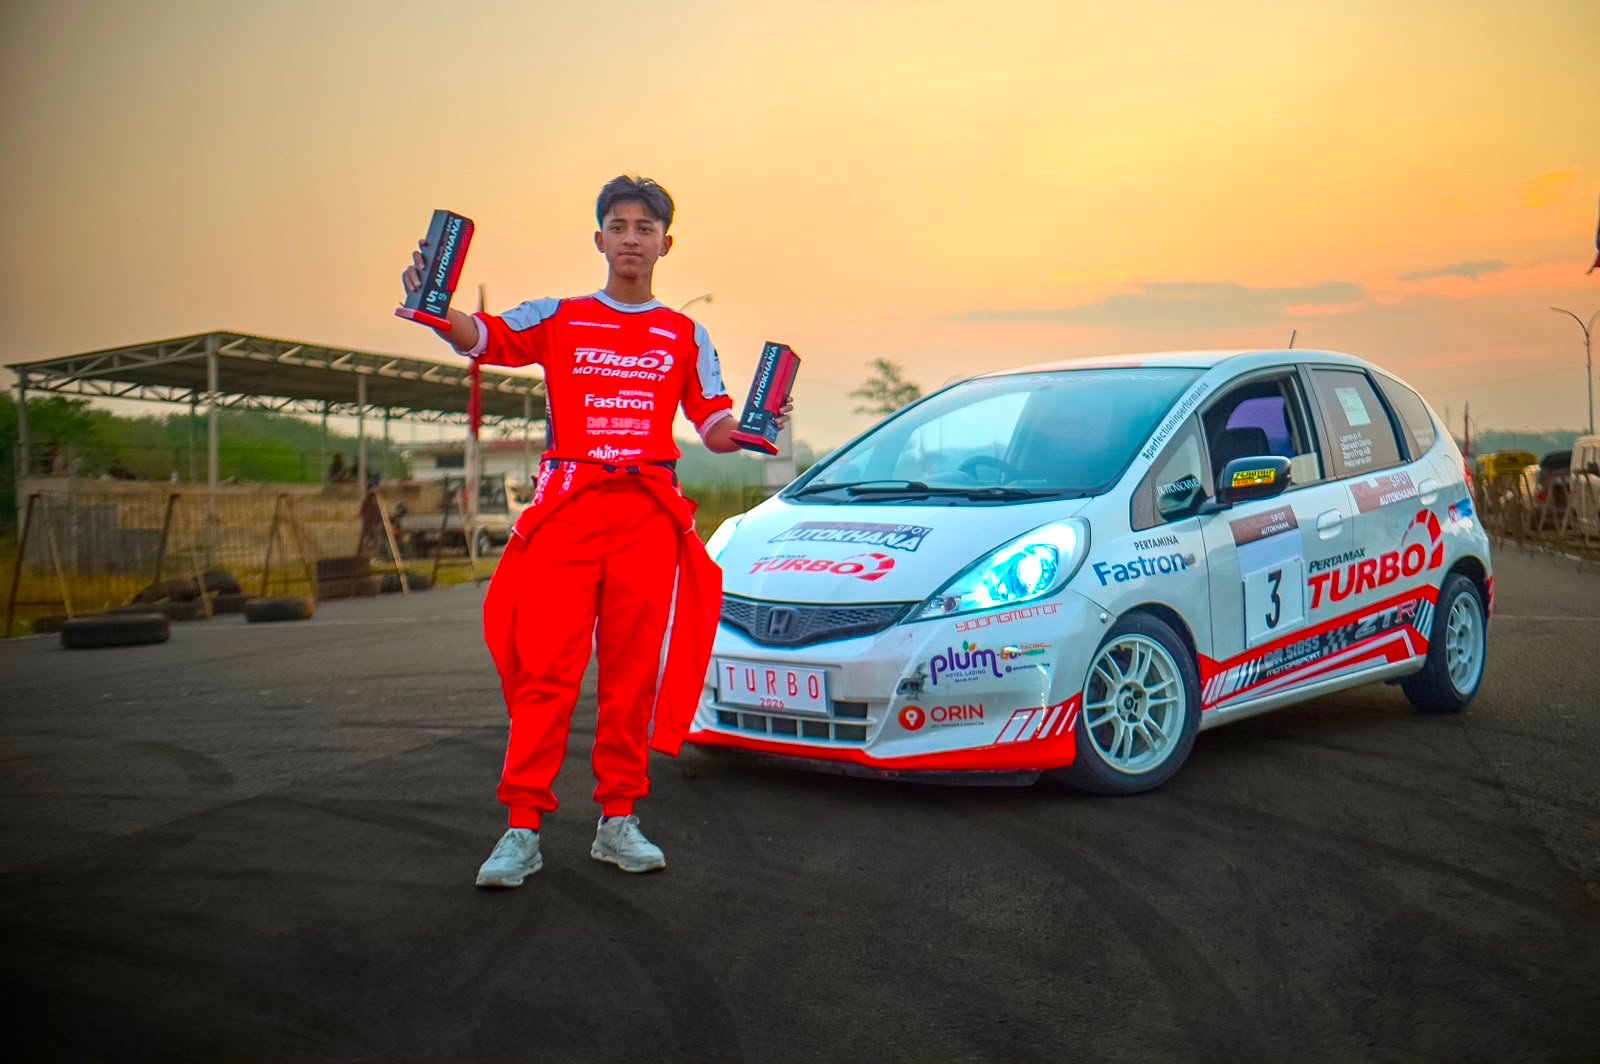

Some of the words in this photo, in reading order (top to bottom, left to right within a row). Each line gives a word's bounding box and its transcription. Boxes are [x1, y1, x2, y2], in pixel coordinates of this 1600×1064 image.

[434, 218, 462, 288] AUTOKHANA
[571, 365, 666, 382] MOTORSPORT
[573, 351, 660, 369] TURBO
[752, 344, 779, 409] AUTOKHANA
[584, 393, 655, 411] Fastron
[772, 528, 919, 550] AUTOKHANA
[894, 524, 930, 536] SPOT
[1133, 534, 1180, 552] PERTAMINA
[749, 558, 865, 575] TURBO
[1092, 552, 1188, 587] Fastron
[1307, 546, 1367, 574] PERTAMAX
[1307, 543, 1427, 611] TURBO
[1264, 568, 1283, 629] 3
[1354, 597, 1418, 640] ZTR
[930, 646, 1003, 686] plum
[726, 665, 819, 700] TURBO
[930, 704, 984, 723] ORIN
